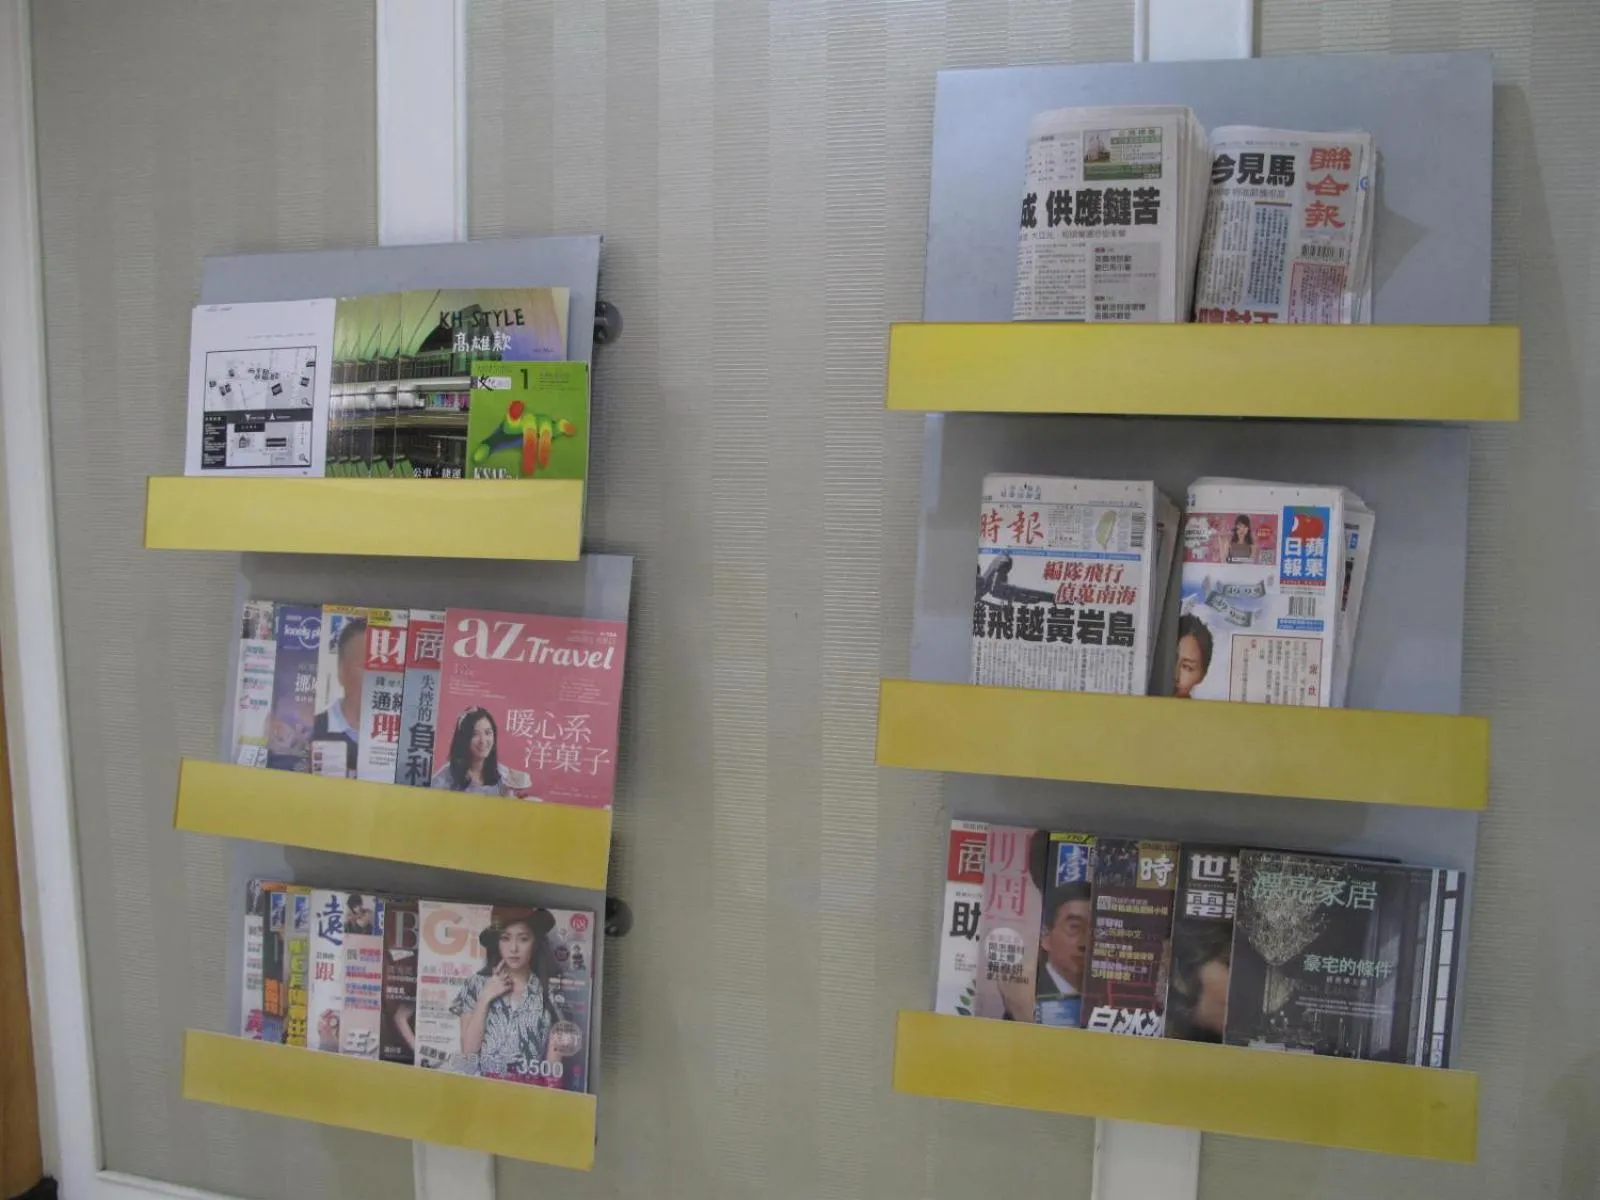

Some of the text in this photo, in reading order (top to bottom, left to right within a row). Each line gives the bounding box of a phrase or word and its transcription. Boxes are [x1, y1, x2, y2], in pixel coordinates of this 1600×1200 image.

[1211, 153, 1296, 187] 今見馬
[1304, 147, 1352, 229] 聯合報
[1046, 187, 1160, 227] 供應鏈苦
[440, 308, 525, 328] KH STYLE
[521, 369, 529, 389] 1
[980, 508, 1044, 544] 時報
[1043, 561, 1124, 583] 編隊飛行
[368, 628, 407, 665] 財
[526, 637, 615, 669] Travel
[506, 708, 592, 743] 暖心系
[525, 740, 610, 775] 洋菓子
[1140, 854, 1174, 887] 時
[316, 894, 344, 946] 遠
[512, 1054, 564, 1078] 3500
